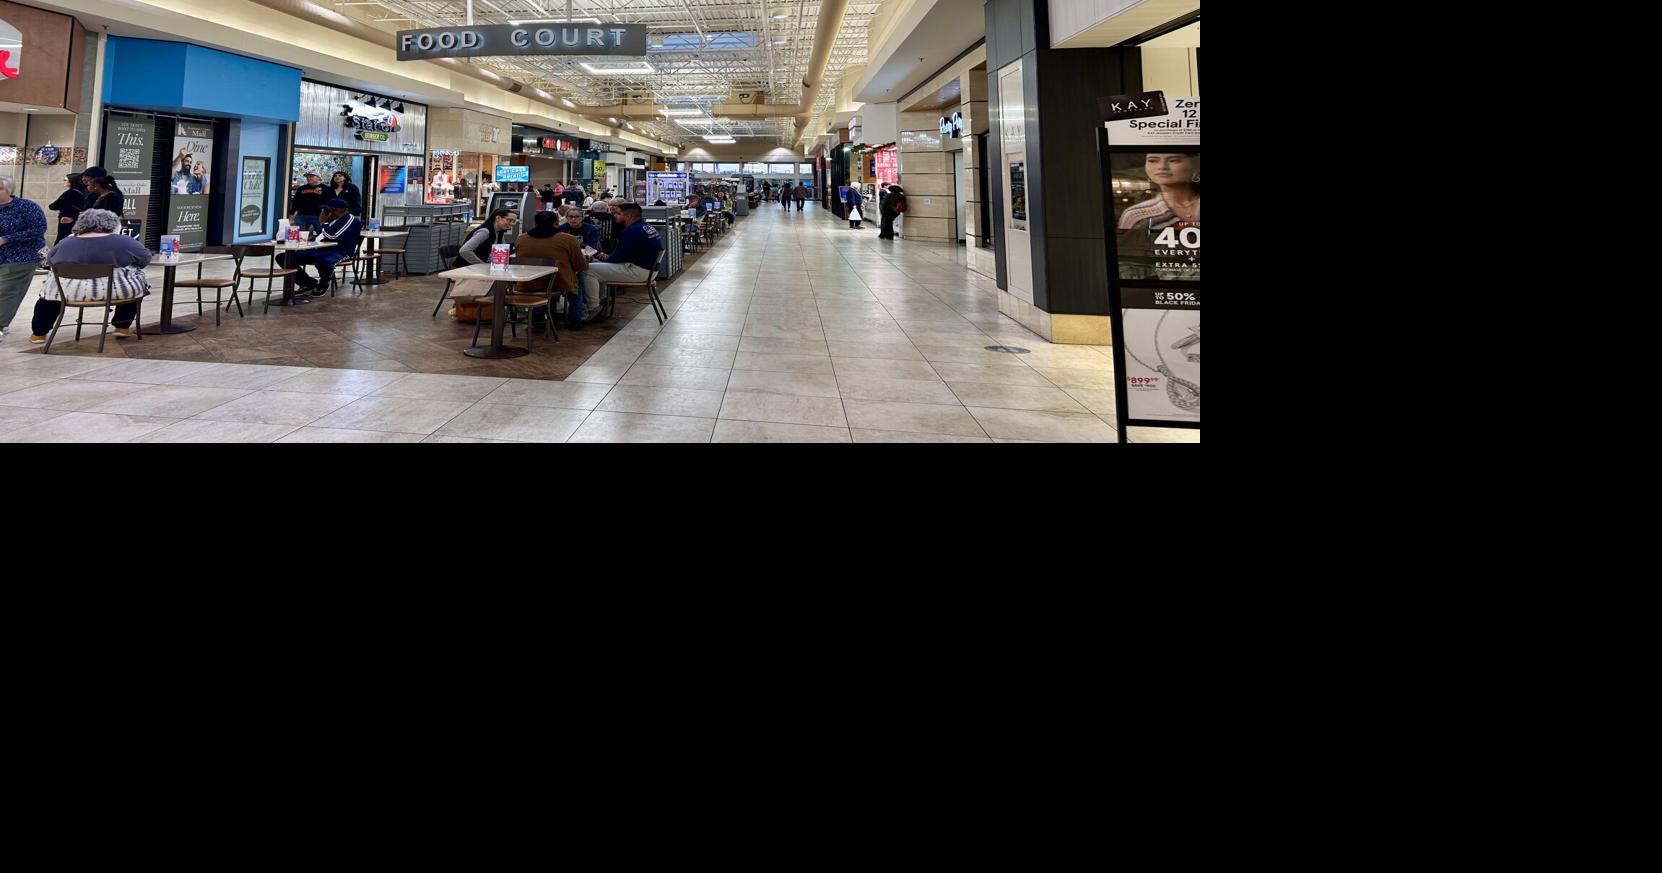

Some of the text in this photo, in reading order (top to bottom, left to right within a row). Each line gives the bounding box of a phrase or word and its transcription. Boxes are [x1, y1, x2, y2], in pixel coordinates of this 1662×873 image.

[401, 28, 626, 51] FOOD COURT
[1111, 99, 1151, 112] KAY
[1182, 110, 1197, 118] 12
[1130, 120, 1200, 130] Special Fi
[118, 132, 144, 146] This.
[186, 140, 208, 153] Dine
[122, 198, 136, 210] ALL
[176, 211, 200, 222] Here.
[122, 228, 134, 237] ET
[1154, 226, 1200, 248] 40
[1167, 292, 1196, 300] 50%
